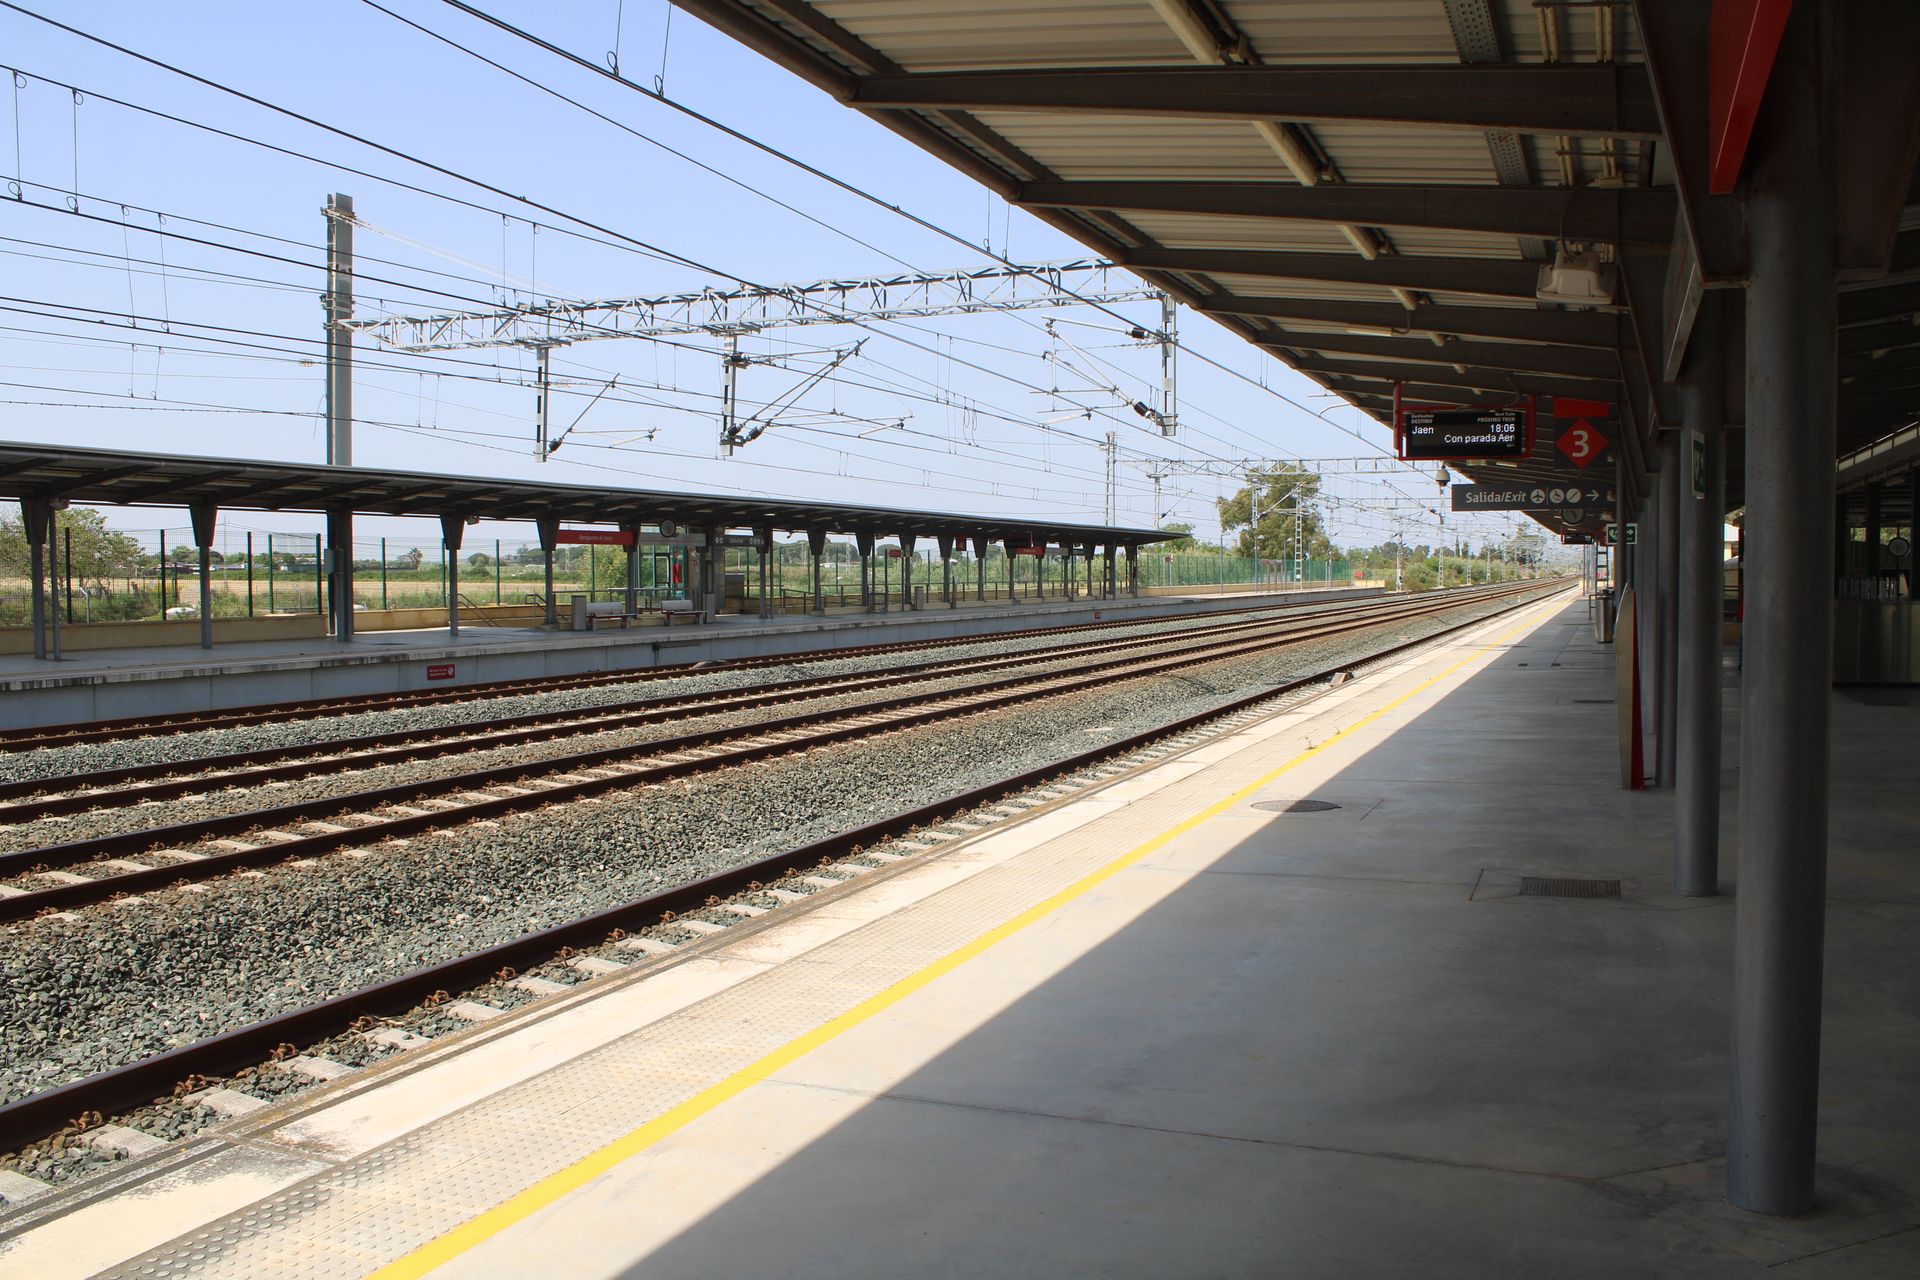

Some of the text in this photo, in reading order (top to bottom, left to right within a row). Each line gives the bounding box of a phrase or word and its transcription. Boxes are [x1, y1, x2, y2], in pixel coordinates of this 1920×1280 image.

[1411, 425, 1434, 435] Jaen
[1490, 423, 1515, 433] 18:06
[1444, 434, 1462, 443] Con
[1465, 433, 1496, 444] parada
[1572, 430, 1589, 457] 3
[1465, 491, 1526, 503] Salida/Exit
